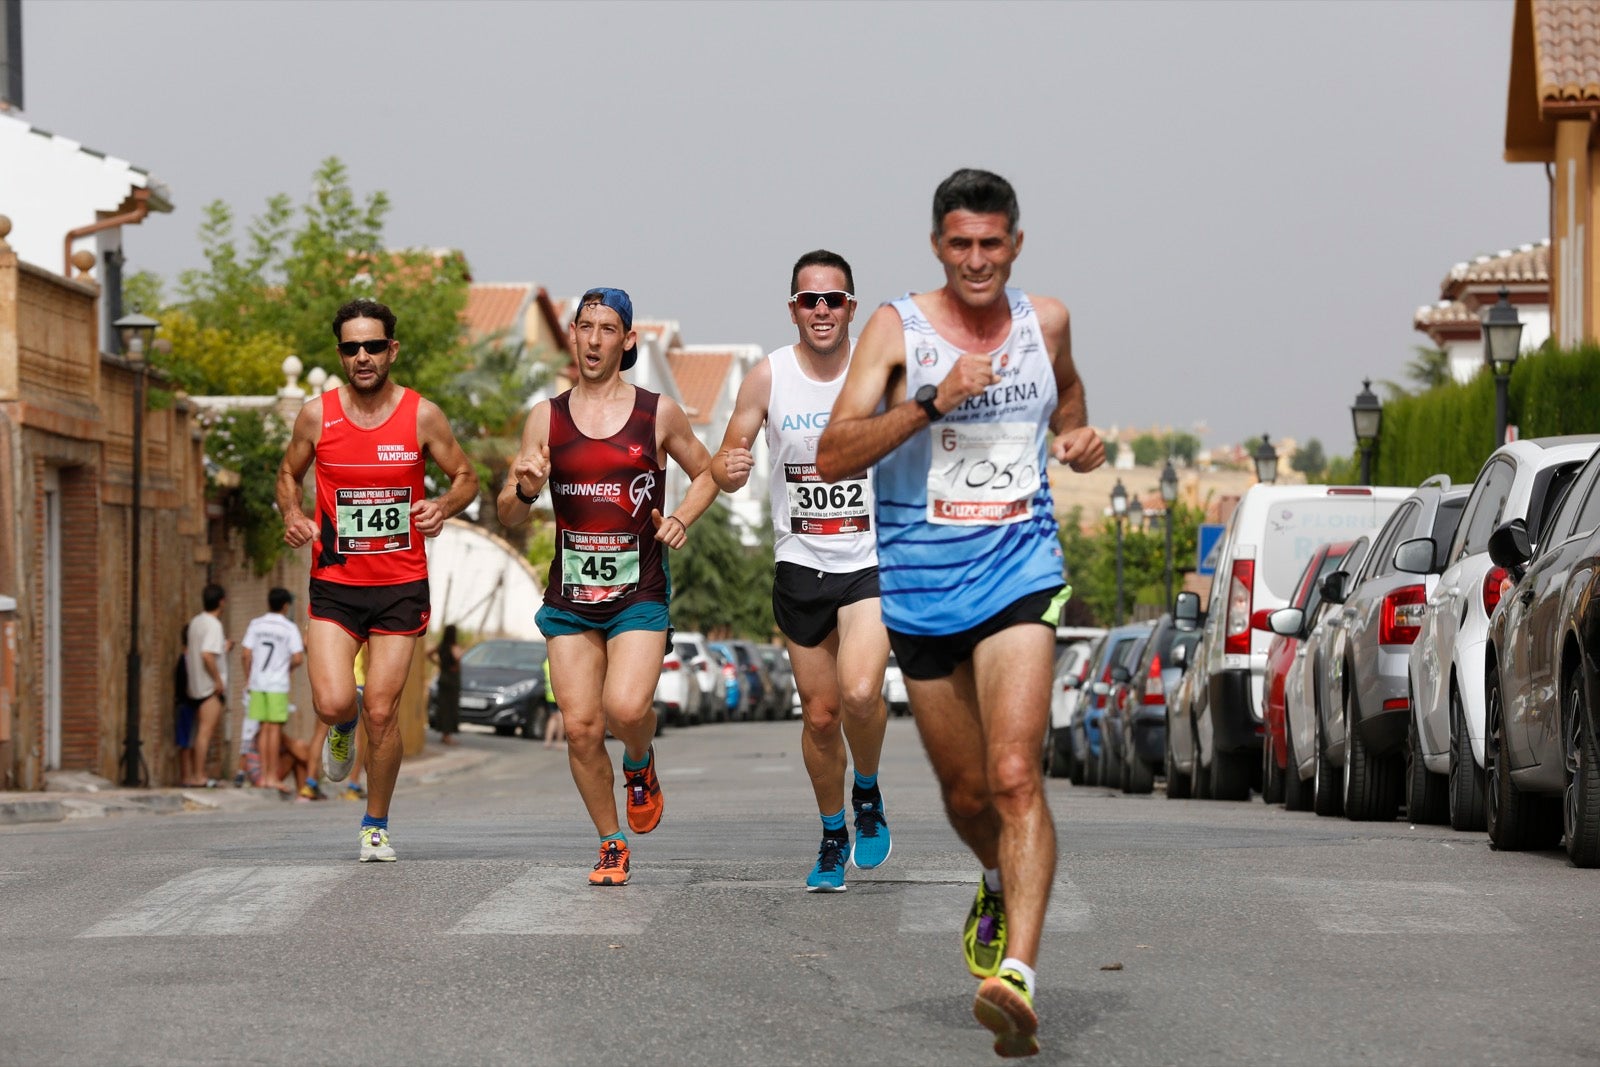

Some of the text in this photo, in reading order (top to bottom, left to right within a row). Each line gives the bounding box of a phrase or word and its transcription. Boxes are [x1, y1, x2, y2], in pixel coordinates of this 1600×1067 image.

[956, 382, 1038, 411] RACENA
[377, 452, 418, 461] VAMPIROS
[802, 465, 817, 475] GRAN
[353, 490, 367, 499] GRAN
[367, 490, 385, 498] PREMIO
[391, 489, 407, 497] FONDO
[797, 484, 864, 510] 3062
[352, 507, 400, 532] 148
[575, 534, 589, 544] GRAN
[589, 535, 609, 545] PREMIO
[609, 537, 616, 545] DE
[581, 556, 618, 581] 45
[262, 642, 274, 671] 7
